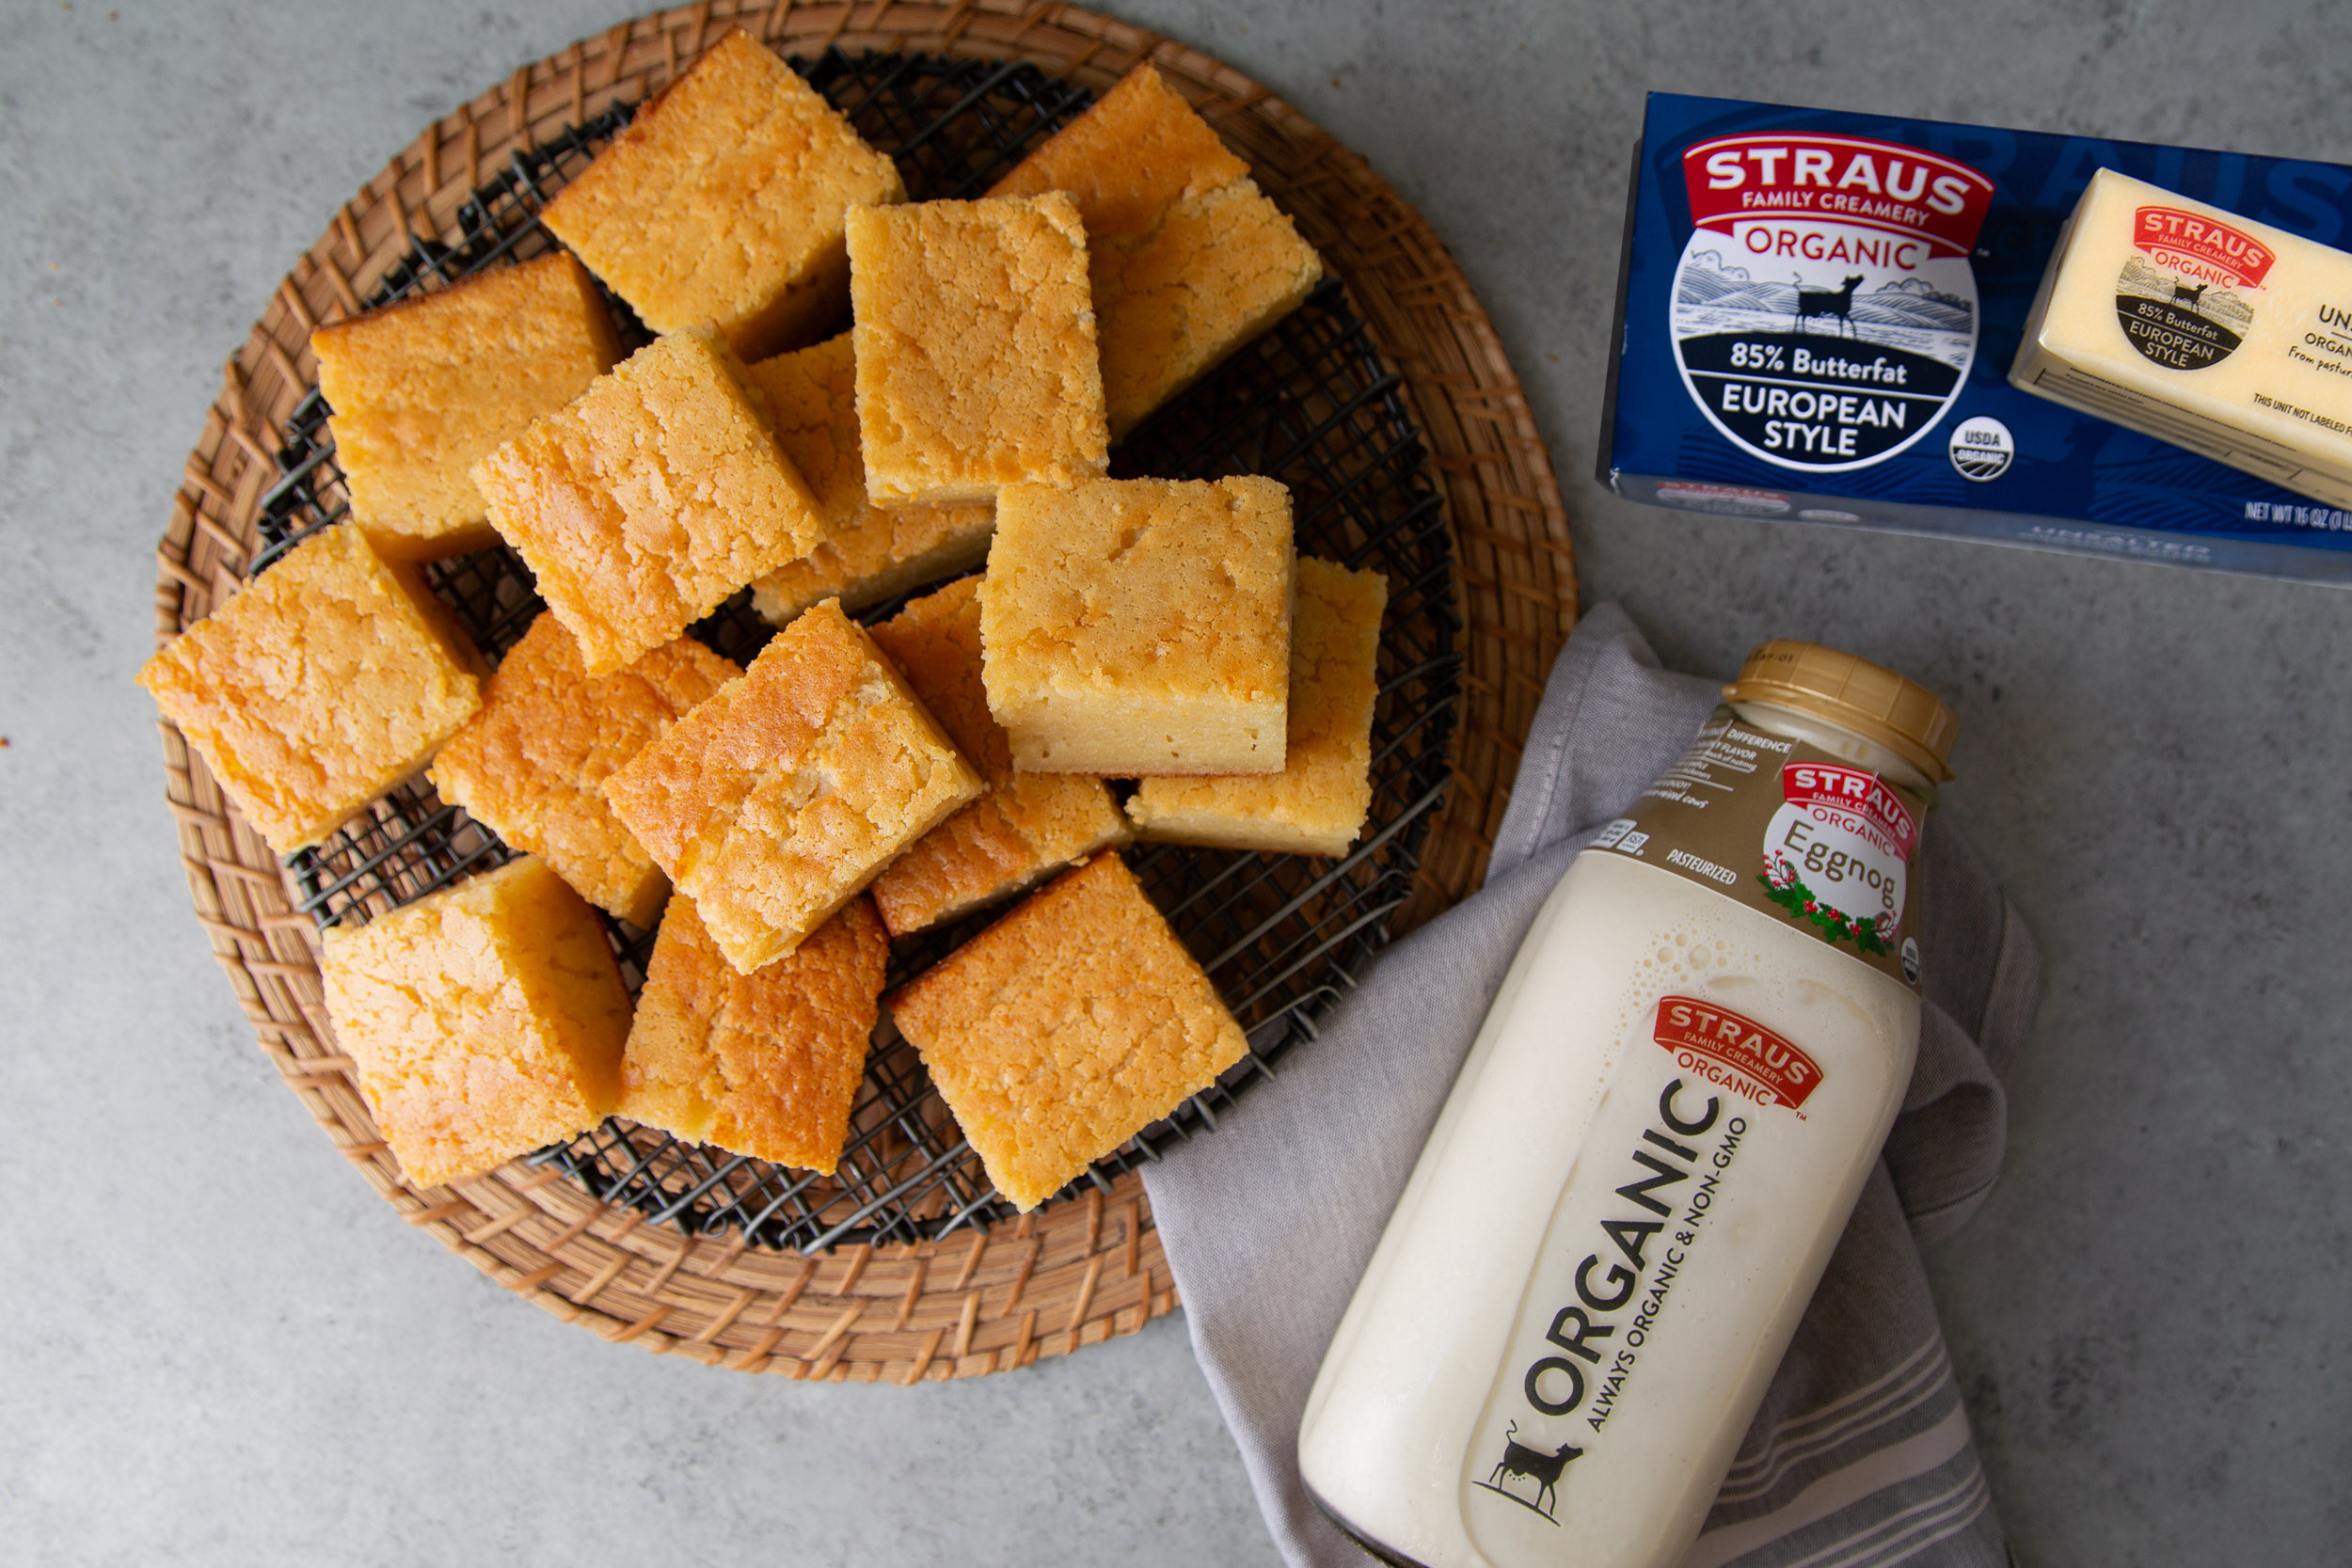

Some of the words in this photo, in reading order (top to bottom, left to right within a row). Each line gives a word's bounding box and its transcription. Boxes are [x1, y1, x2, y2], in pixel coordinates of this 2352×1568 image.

[1706, 147, 1971, 215] STRAUS
[1741, 190, 1814, 209] FAMILY
[1819, 192, 1931, 228] CREAMERY
[1745, 226, 1919, 270] ORGANIC
[2144, 213, 2265, 268] STRAUS
[2158, 234, 2192, 249] FAMILY
[2193, 242, 2244, 270] CREAMERY
[2155, 250, 2235, 289] ORGANIC
[2137, 303, 2163, 321] 85%
[2166, 311, 2218, 341] Butterfat
[2319, 304, 2352, 331] UN
[2129, 320, 2215, 360] EUROPEAN
[2145, 341, 2189, 368] STYLE
[2288, 345, 2314, 364] From
[1730, 341, 1786, 372] 85%
[1792, 347, 1908, 386] Butterfat
[1722, 383, 1907, 430] EUROPEAN
[2253, 392, 2273, 407] THIS
[2273, 399, 2293, 415] UNIT
[2293, 406, 2311, 420] NOT
[2310, 412, 2345, 433] LABELED
[2345, 425, 2352, 436] F
[1763, 420, 1859, 456] STYLE
[1957, 449, 2006, 466] ORGANIC
[1964, 430, 2001, 446] USDA
[2245, 501, 2271, 521] NET
[2271, 503, 2294, 524] WT
[2294, 506, 2310, 526] 16
[2310, 508, 2329, 529] OZ
[1721, 743, 1757, 761] FLAVOR
[1726, 728, 1792, 753] DIFFERENCE
[1794, 768, 1911, 840] STRAUS
[1813, 792, 1852, 807] FAMILY
[1854, 800, 1897, 839] CREAMERY
[1812, 807, 1892, 857] ORGANIC
[1666, 848, 1737, 885] PASTEURIZED
[1783, 819, 1895, 910] Eggnog
[1669, 1005, 1810, 1085] STRAUS
[1683, 1032, 1724, 1052] FAMILY
[1725, 1047, 1784, 1085] CREAMERY
[1677, 1052, 1772, 1106] ORGANIC
[1683, 1117, 1747, 1227] NON-GMO
[1524, 1078, 1720, 1416] ORGANIC
[1675, 1229, 1695, 1246] &
[1627, 1246, 1686, 1348] ORGANIC
[1586, 1350, 1636, 1433] ALWAYS
